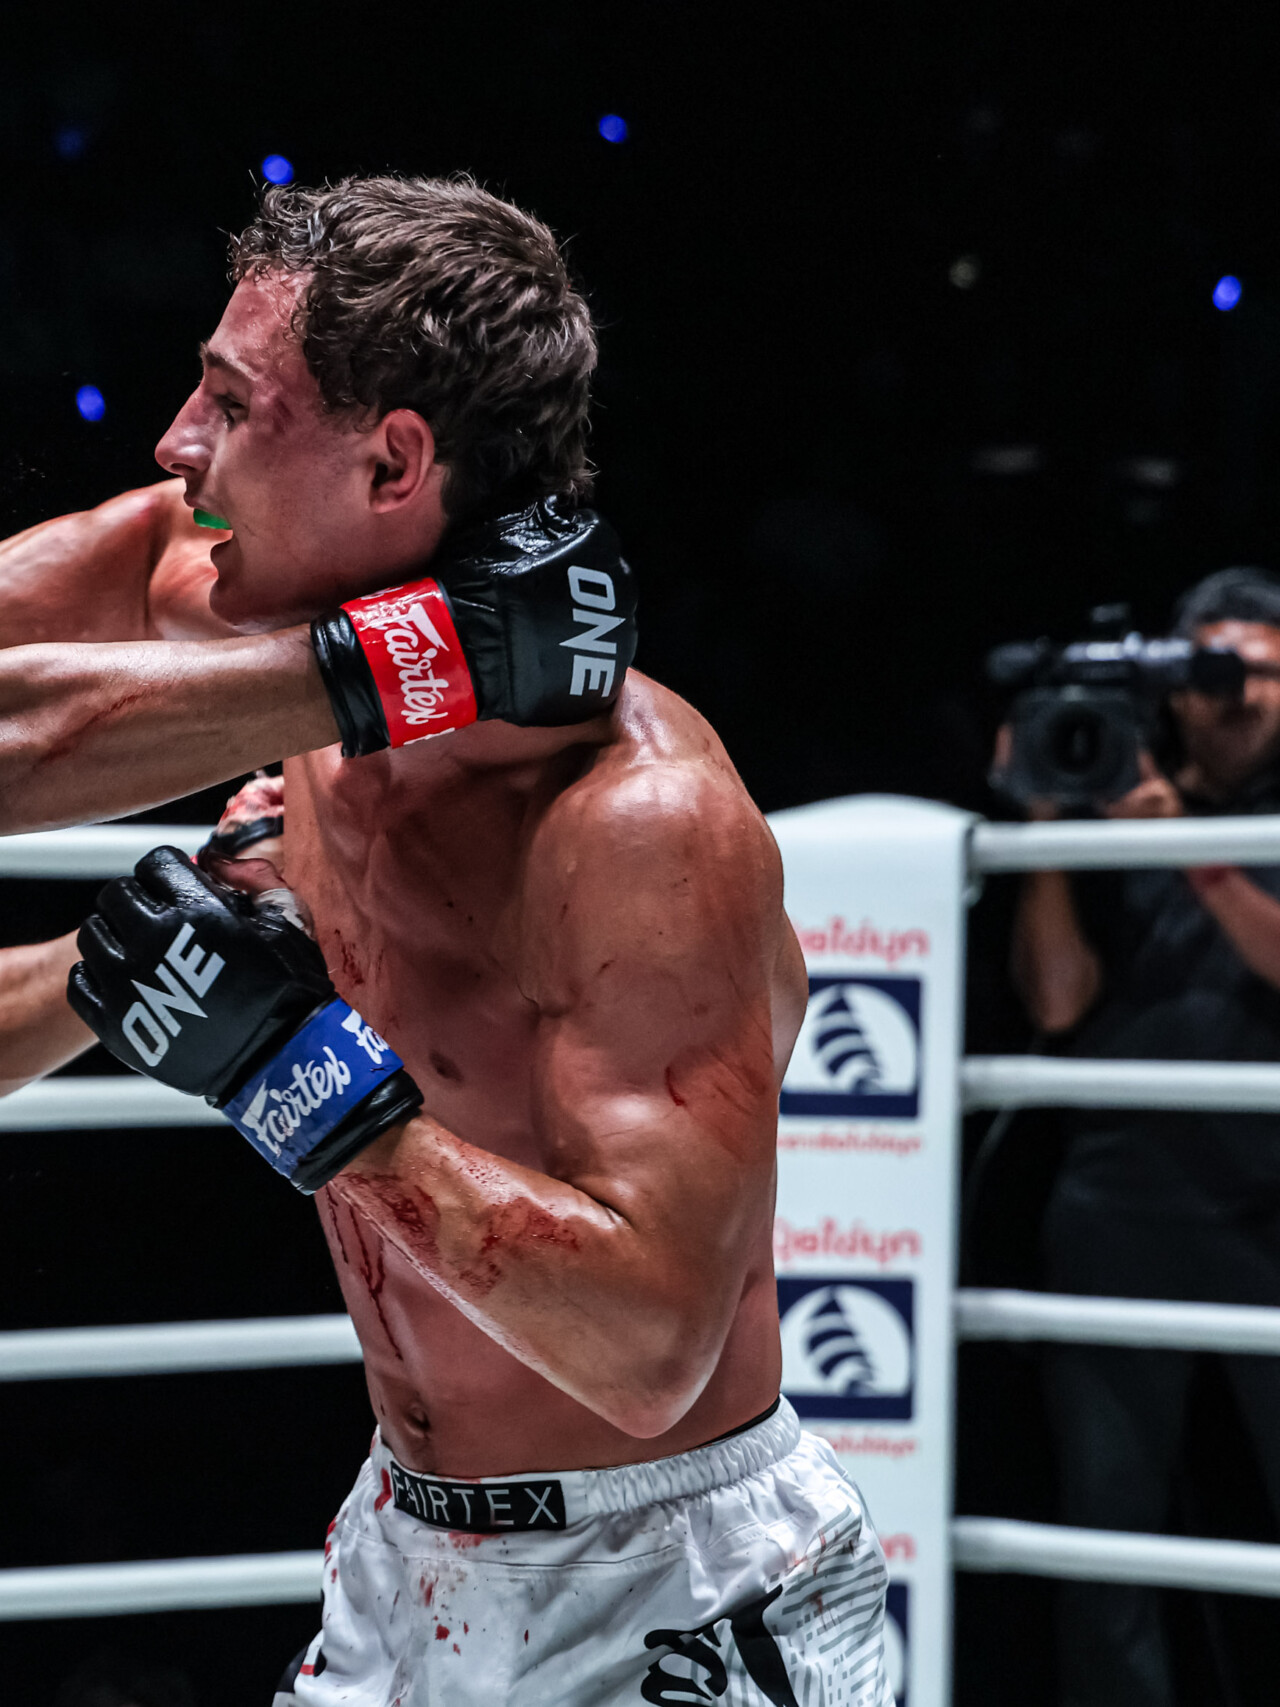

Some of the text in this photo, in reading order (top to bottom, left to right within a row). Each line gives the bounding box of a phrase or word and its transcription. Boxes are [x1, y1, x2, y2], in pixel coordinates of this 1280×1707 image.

[375, 602, 451, 726] Fairtex
[559, 565, 626, 697] ONE
[122, 922, 226, 1067] ONE
[240, 1046, 352, 1158] Fairtex
[392, 1467, 558, 1526] FAIRTEX
